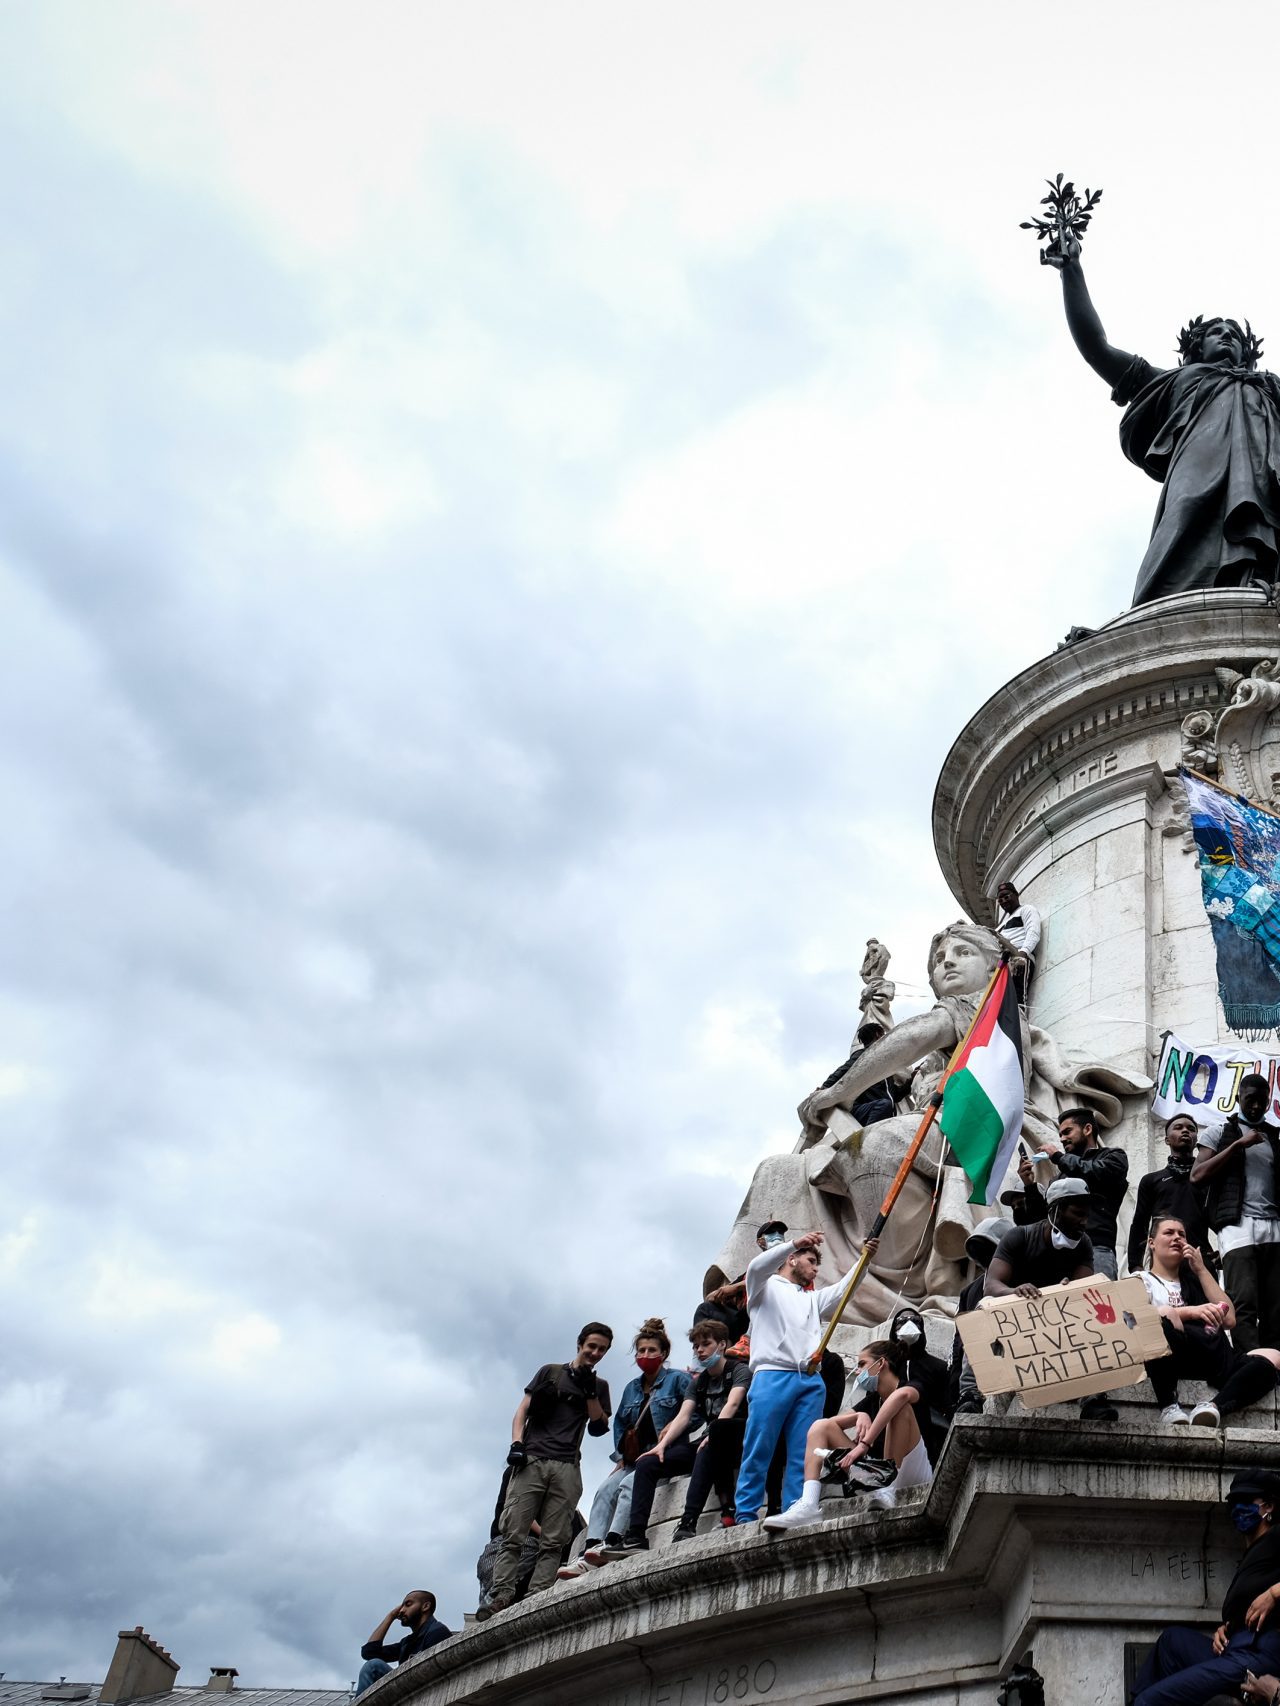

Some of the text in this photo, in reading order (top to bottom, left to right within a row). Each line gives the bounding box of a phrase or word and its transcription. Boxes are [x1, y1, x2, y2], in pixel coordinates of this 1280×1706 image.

[1159, 1047, 1218, 1105] NO
[991, 1296, 1080, 1339] BLACK
[1007, 1318, 1104, 1360] LIVES
[1014, 1340, 1137, 1387] MATTER
[1131, 1552, 1155, 1577] LA
[1167, 1552, 1219, 1580] FÊTE
[704, 1658, 777, 1706] 1880
